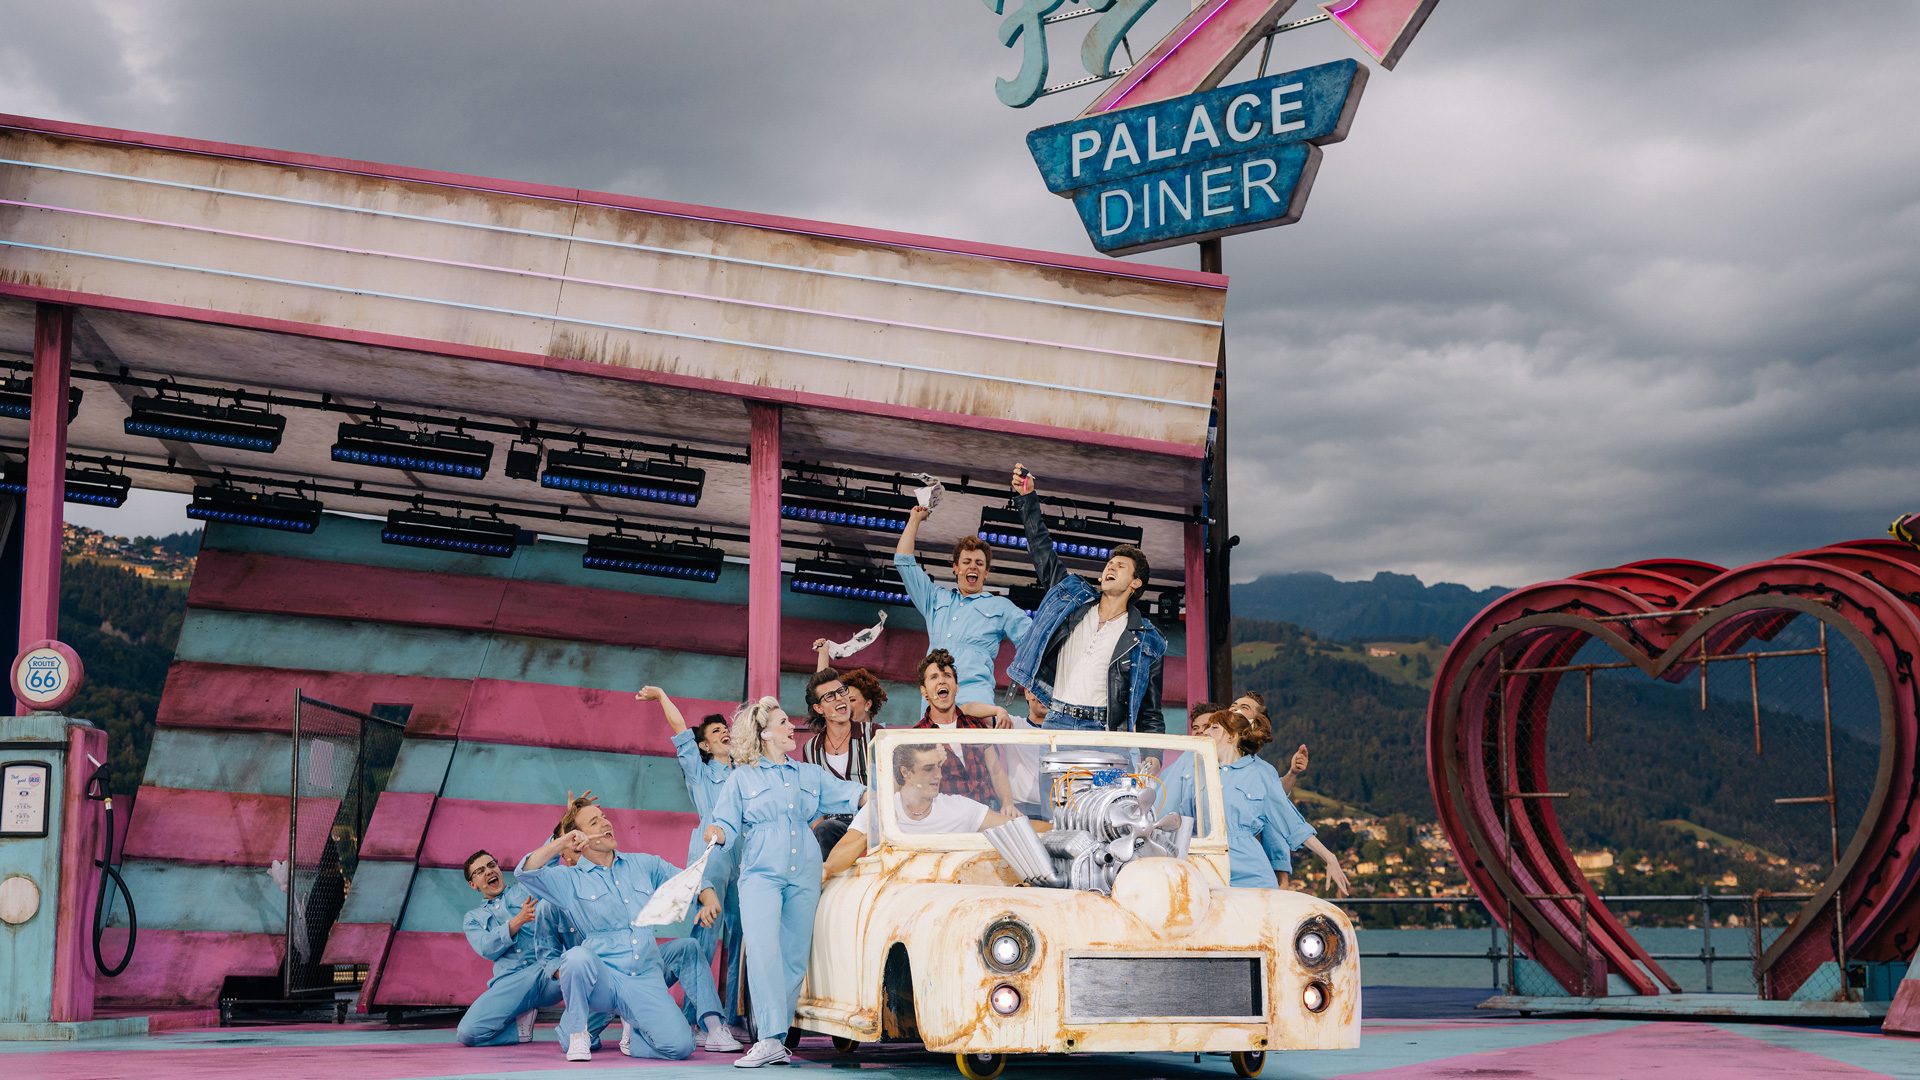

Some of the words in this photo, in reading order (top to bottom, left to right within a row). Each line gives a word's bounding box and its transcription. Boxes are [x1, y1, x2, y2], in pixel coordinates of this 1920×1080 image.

[1071, 82, 1306, 178] PALACE
[1100, 158, 1281, 238] DINER
[30, 670, 56, 688] 66
